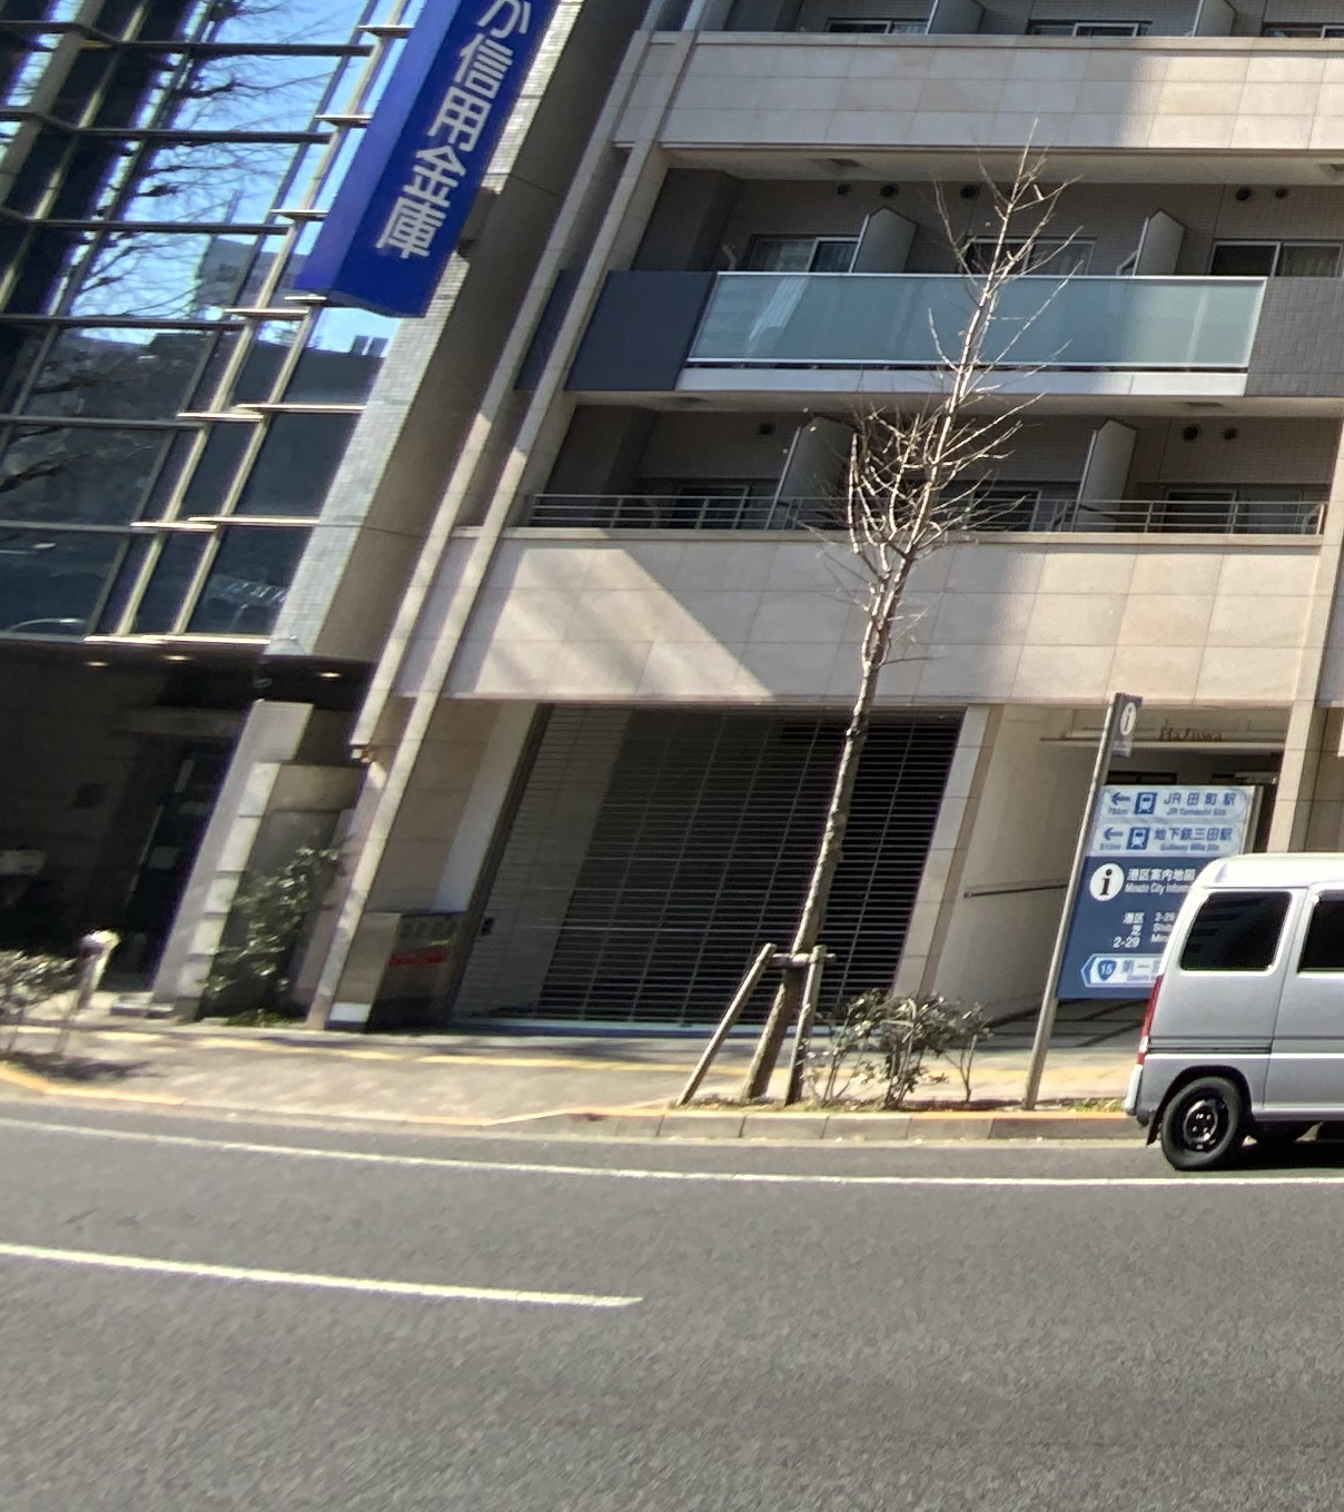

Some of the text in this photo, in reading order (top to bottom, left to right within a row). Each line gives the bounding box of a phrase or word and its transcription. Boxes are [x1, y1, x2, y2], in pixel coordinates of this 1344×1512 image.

[1164, 792, 1182, 805] JR
[1154, 827, 1233, 841] 地下鉄三田駅
[1113, 936, 1141, 948] 2-29
